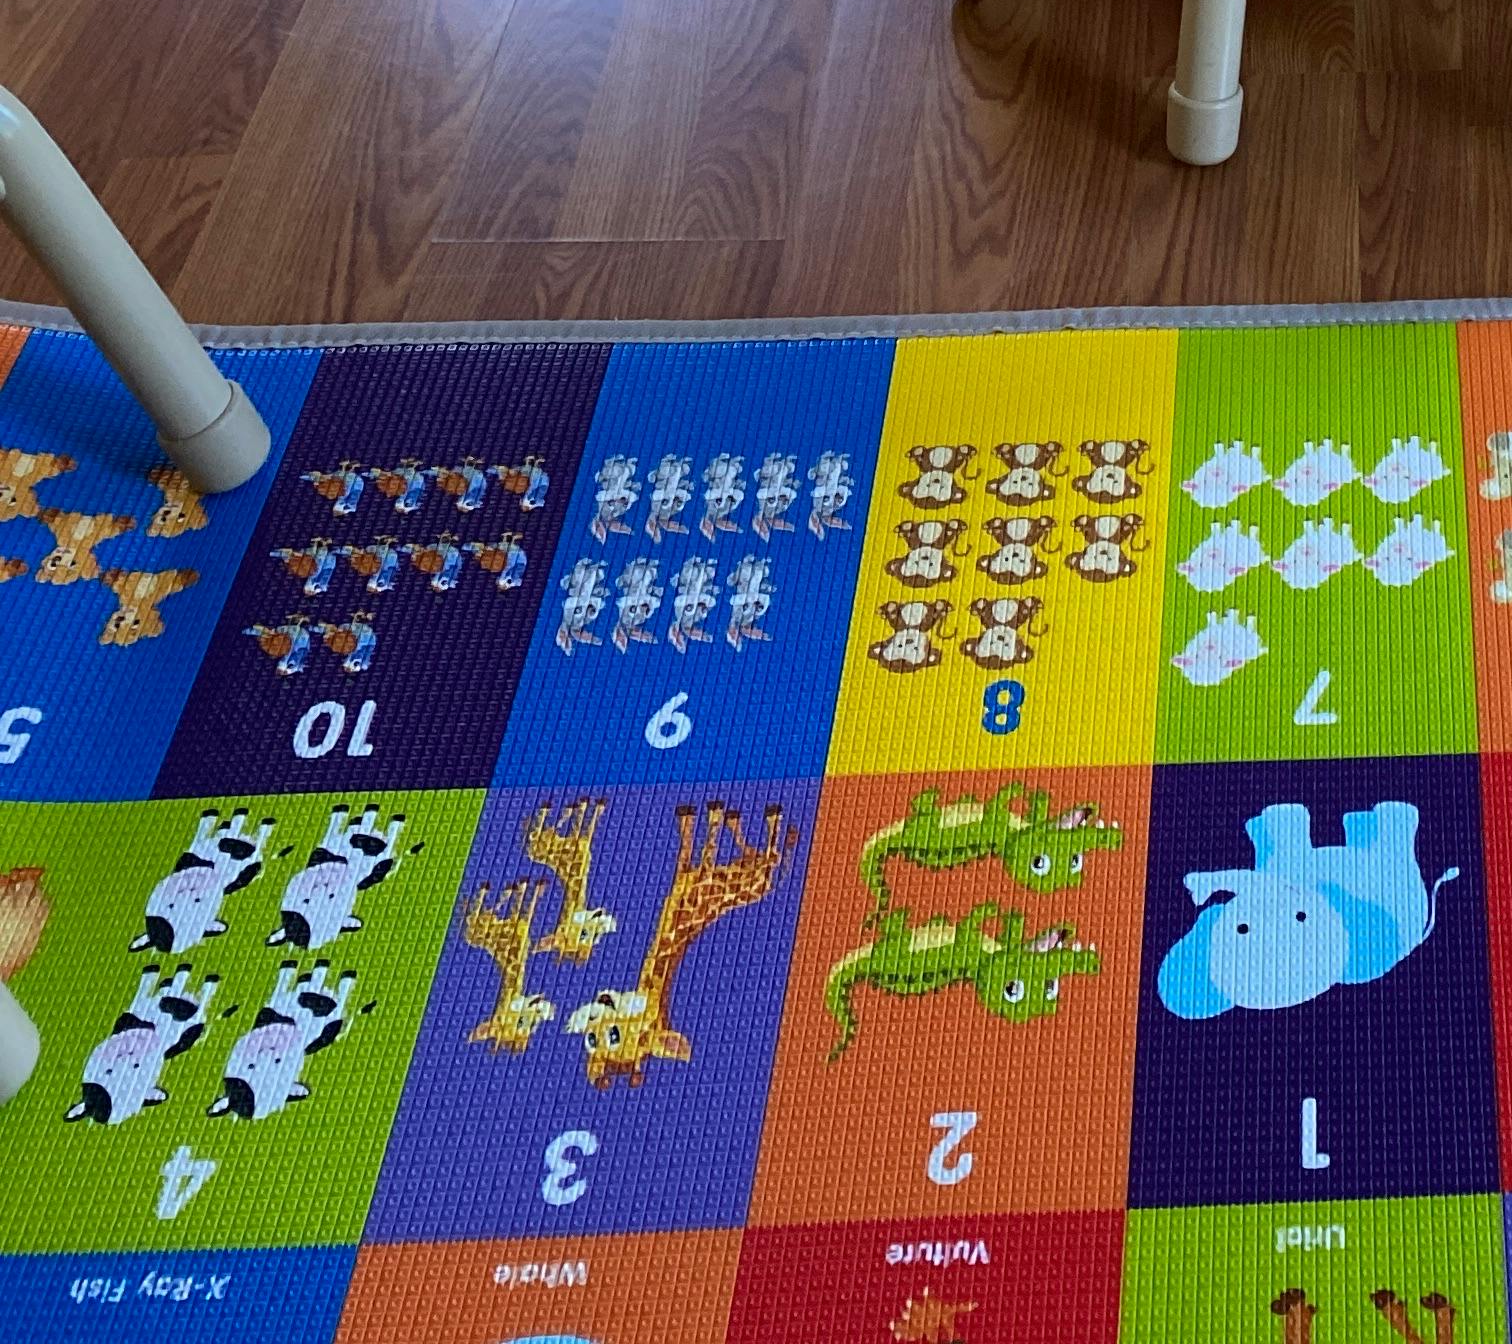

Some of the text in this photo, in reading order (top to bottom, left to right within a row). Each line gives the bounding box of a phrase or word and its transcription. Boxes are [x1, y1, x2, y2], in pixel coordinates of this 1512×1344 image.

[982, 679, 1025, 735] 8
[1293, 670, 1338, 725] 7
[293, 698, 377, 759] 10
[926, 1111, 978, 1185] 2
[1301, 1097, 1331, 1169] 1
[156, 1145, 216, 1220] 4
[541, 1130, 598, 1206] 3
[492, 1260, 588, 1288] Whale
[885, 1240, 991, 1266] Vulture
[70, 1273, 232, 1304] X-Ray Fish
